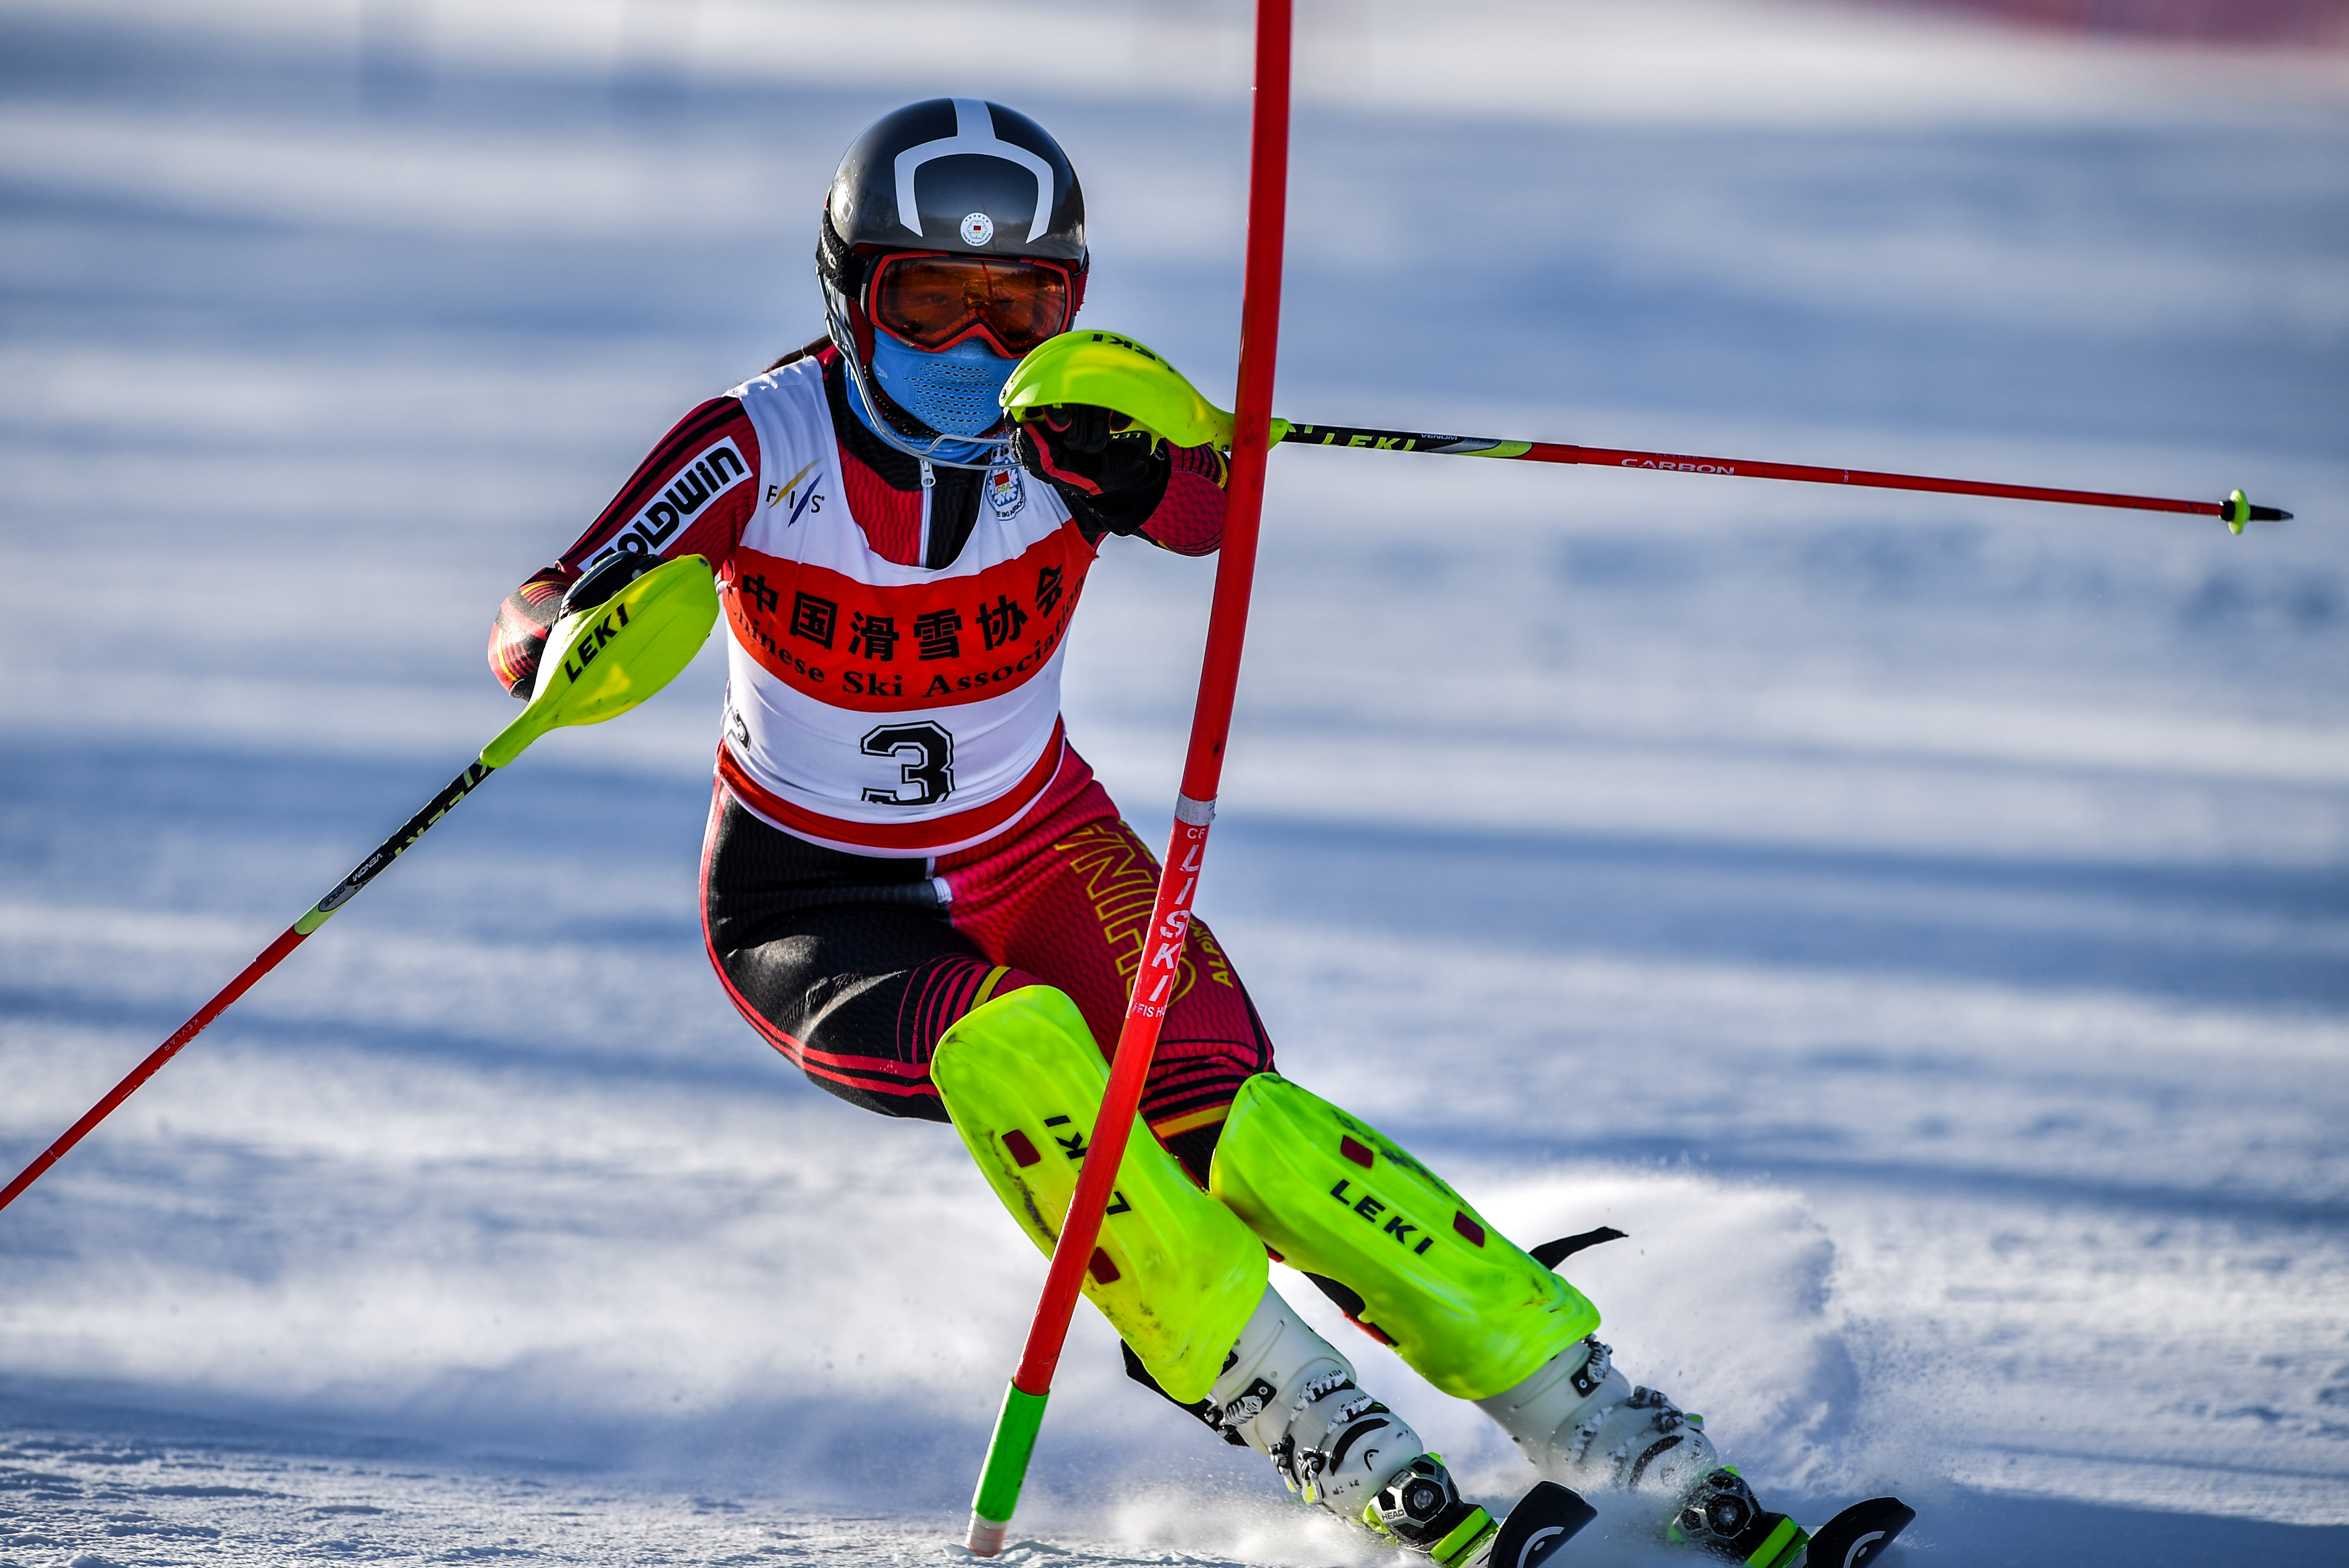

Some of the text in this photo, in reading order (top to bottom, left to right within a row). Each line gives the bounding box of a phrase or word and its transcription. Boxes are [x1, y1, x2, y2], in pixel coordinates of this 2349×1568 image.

[1321, 432, 1416, 451] LEKI
[1621, 458, 1735, 475] CARBON
[565, 603, 629, 684] LEKI
[742, 564, 1063, 662] 中国滑雪协会
[842, 670, 903, 698] Ski
[921, 576, 1084, 697] Association
[860, 720, 955, 805] 3
[352, 853, 383, 882] VENOM
[1148, 844, 1202, 1002] LISKI
[163, 1018, 199, 1051] KEVLAR
[1044, 1115, 1131, 1216] LKI
[1330, 1179, 1434, 1255] LEKI
[1381, 1509, 1405, 1521] HEAD
